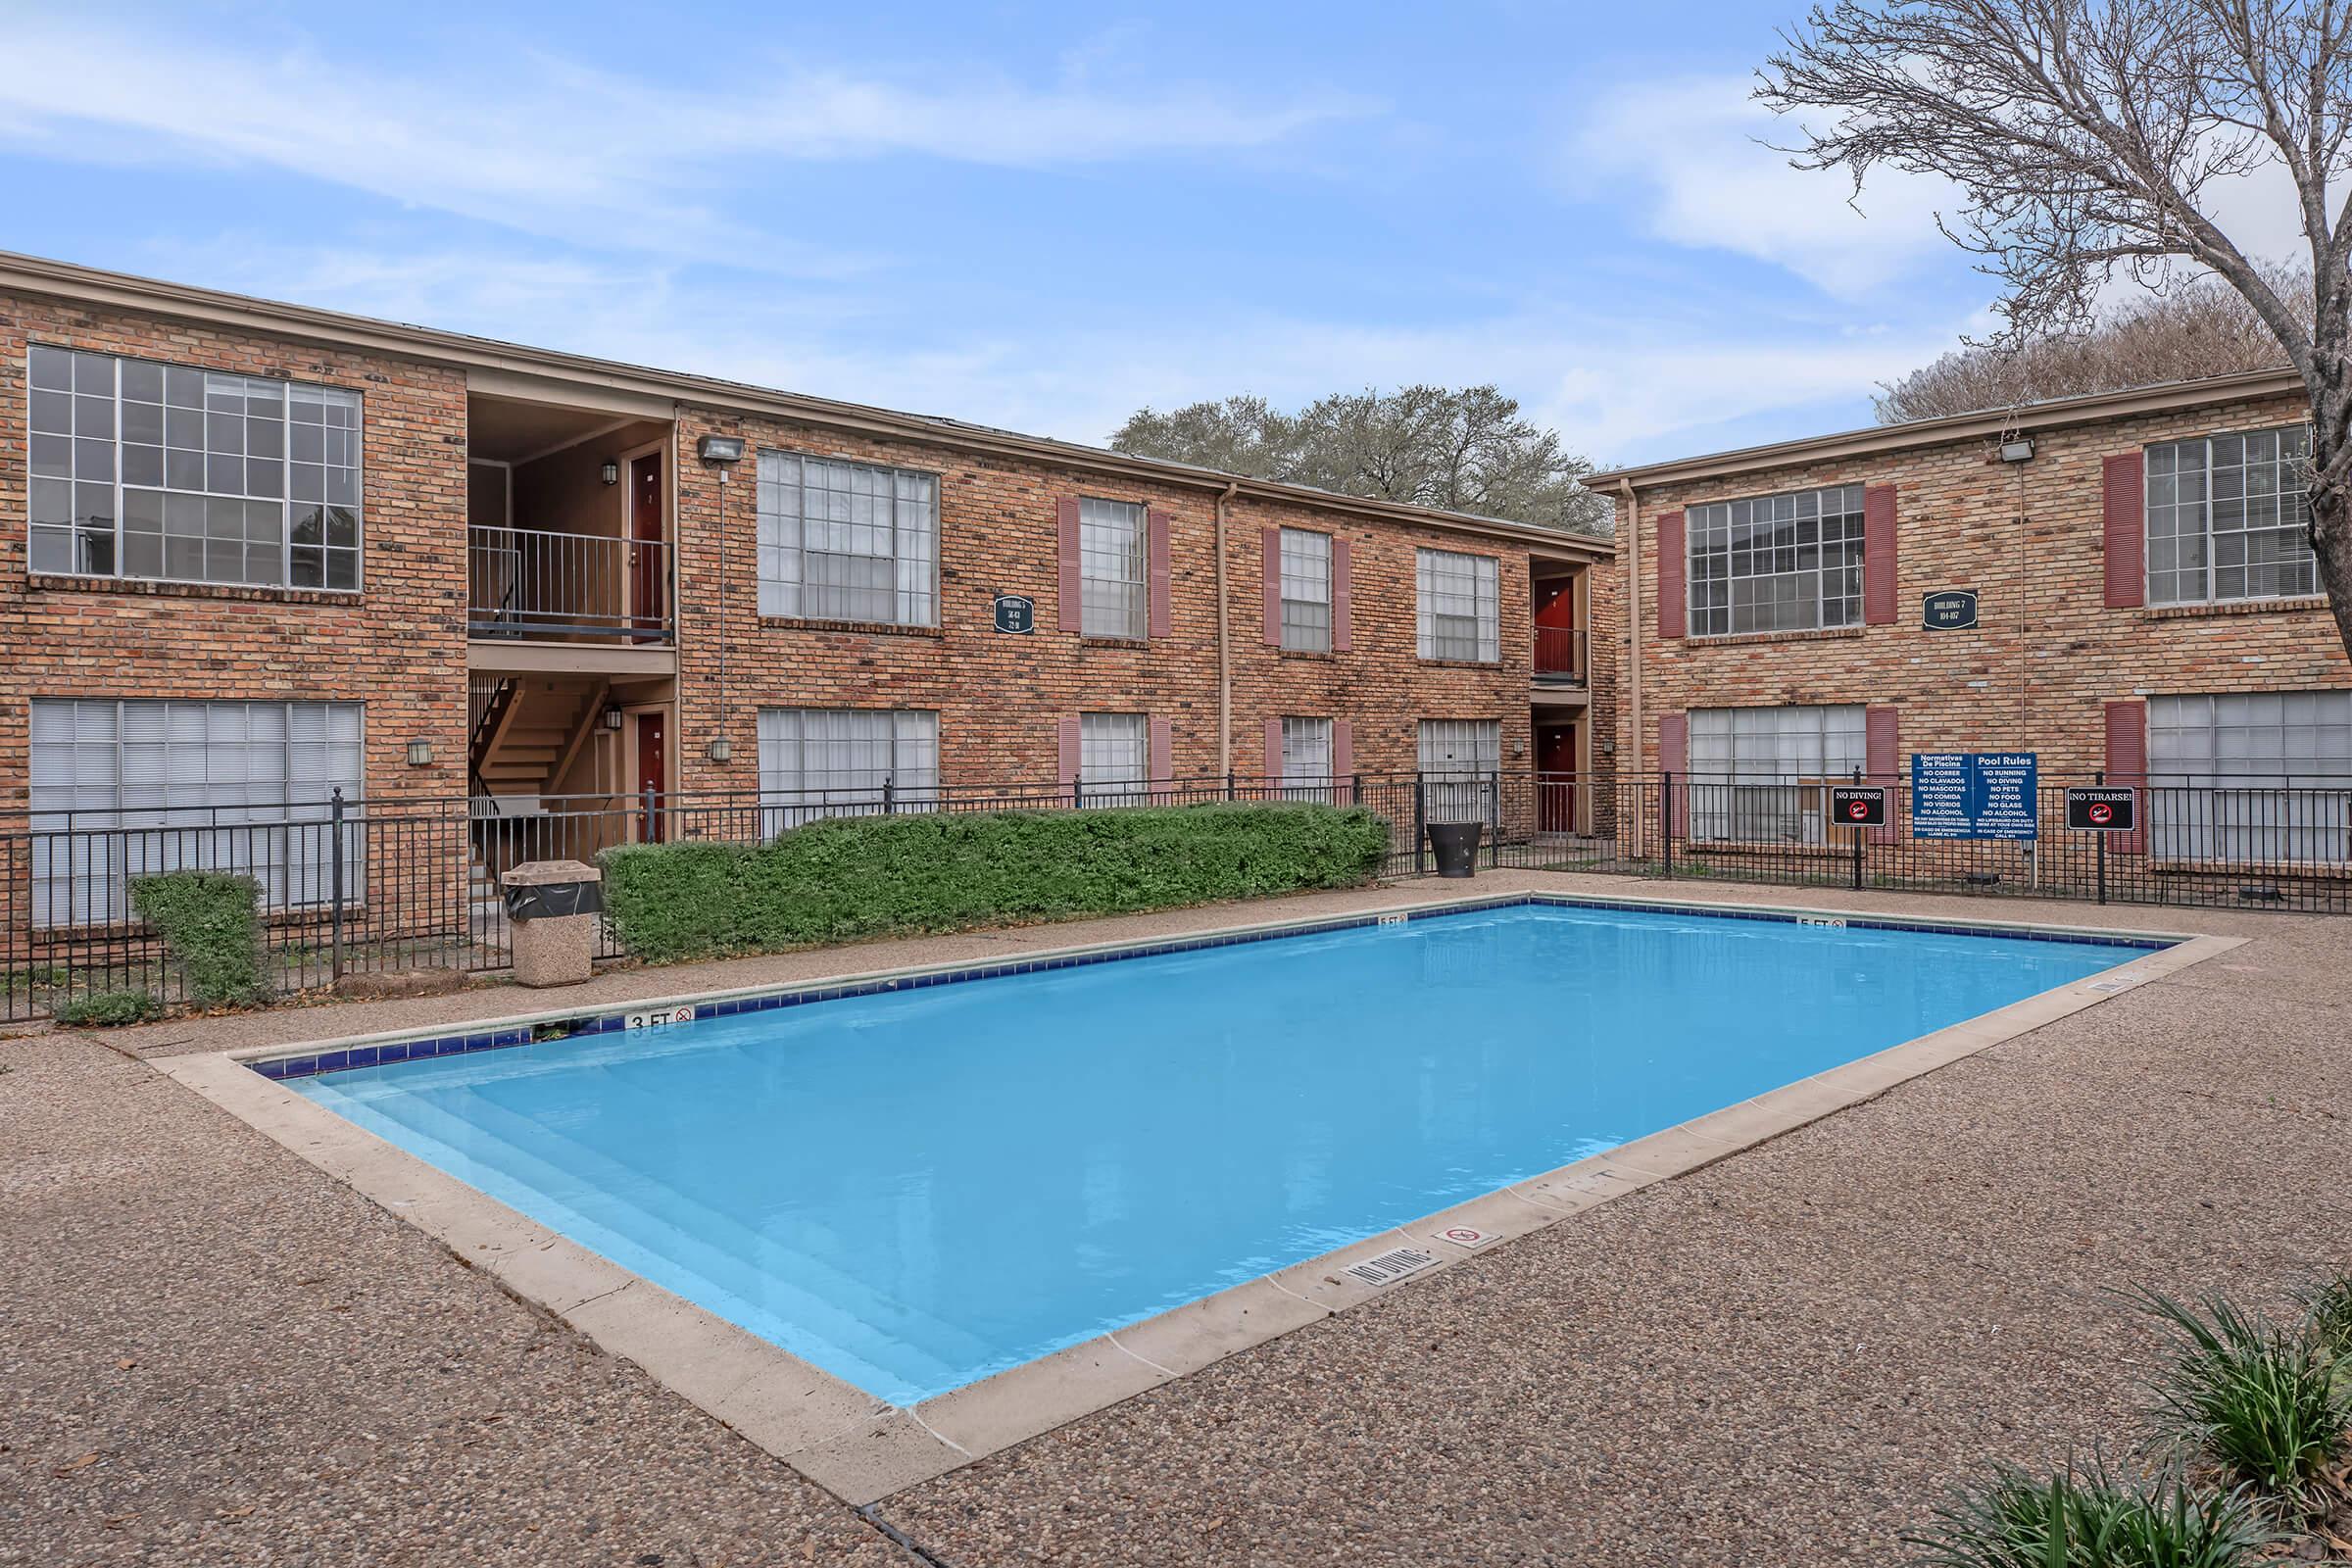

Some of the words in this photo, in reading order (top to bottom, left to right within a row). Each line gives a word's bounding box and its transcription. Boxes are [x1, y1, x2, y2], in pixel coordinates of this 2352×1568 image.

[1934, 600, 1960, 610] BUILDING
[1961, 600, 1965, 609] 7
[1978, 757, 2000, 765] Pool
[2003, 757, 2032, 765] Rules
[1836, 791, 1849, 800] NO
[2069, 792, 2086, 800] ¡NO
[2087, 793, 2132, 801] TIRARSE!
[632, 1016, 643, 1028] 3
[650, 1012, 671, 1027] FT
[1348, 1265, 1389, 1283] NO
[1369, 1249, 1433, 1274] DIVING
